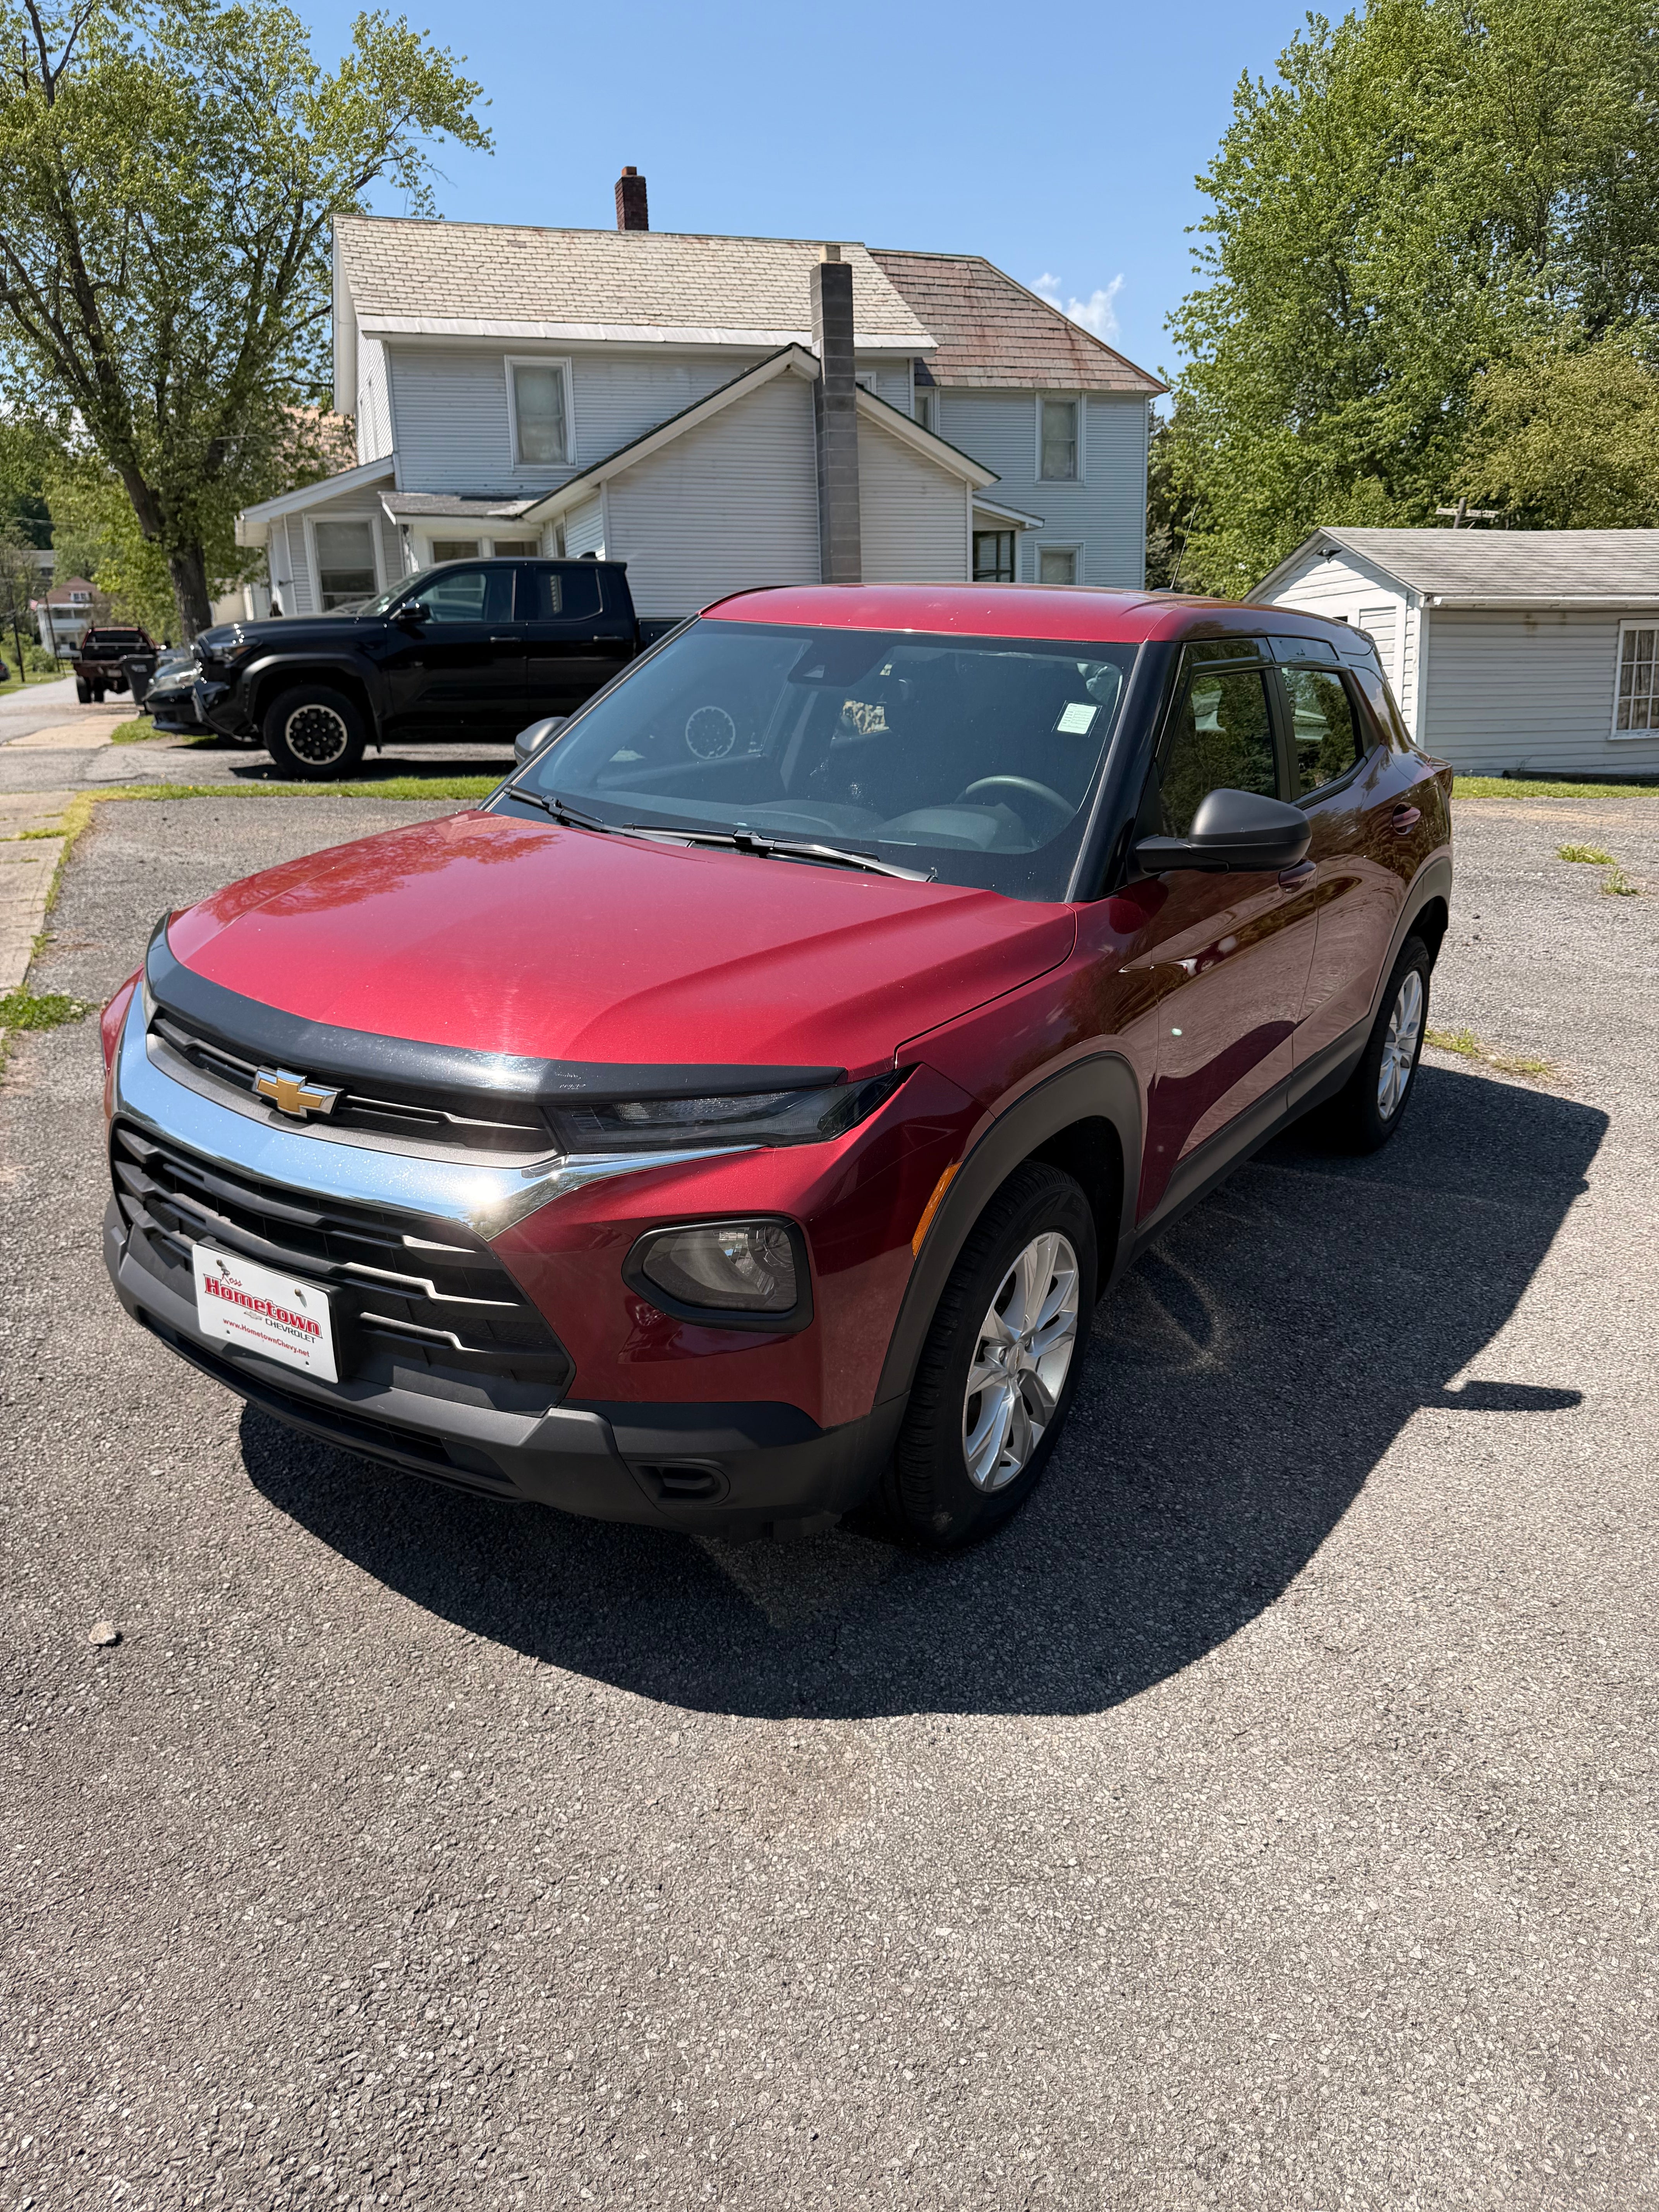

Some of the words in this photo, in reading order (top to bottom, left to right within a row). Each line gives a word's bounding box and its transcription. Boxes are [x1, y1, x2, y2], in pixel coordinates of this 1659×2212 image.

[222, 1268, 243, 1286] Ross
[204, 1276, 321, 1337] Hometown
[223, 1318, 310, 1357] www.HometownChevy.net
[265, 1318, 316, 1343] CHEVROLET
